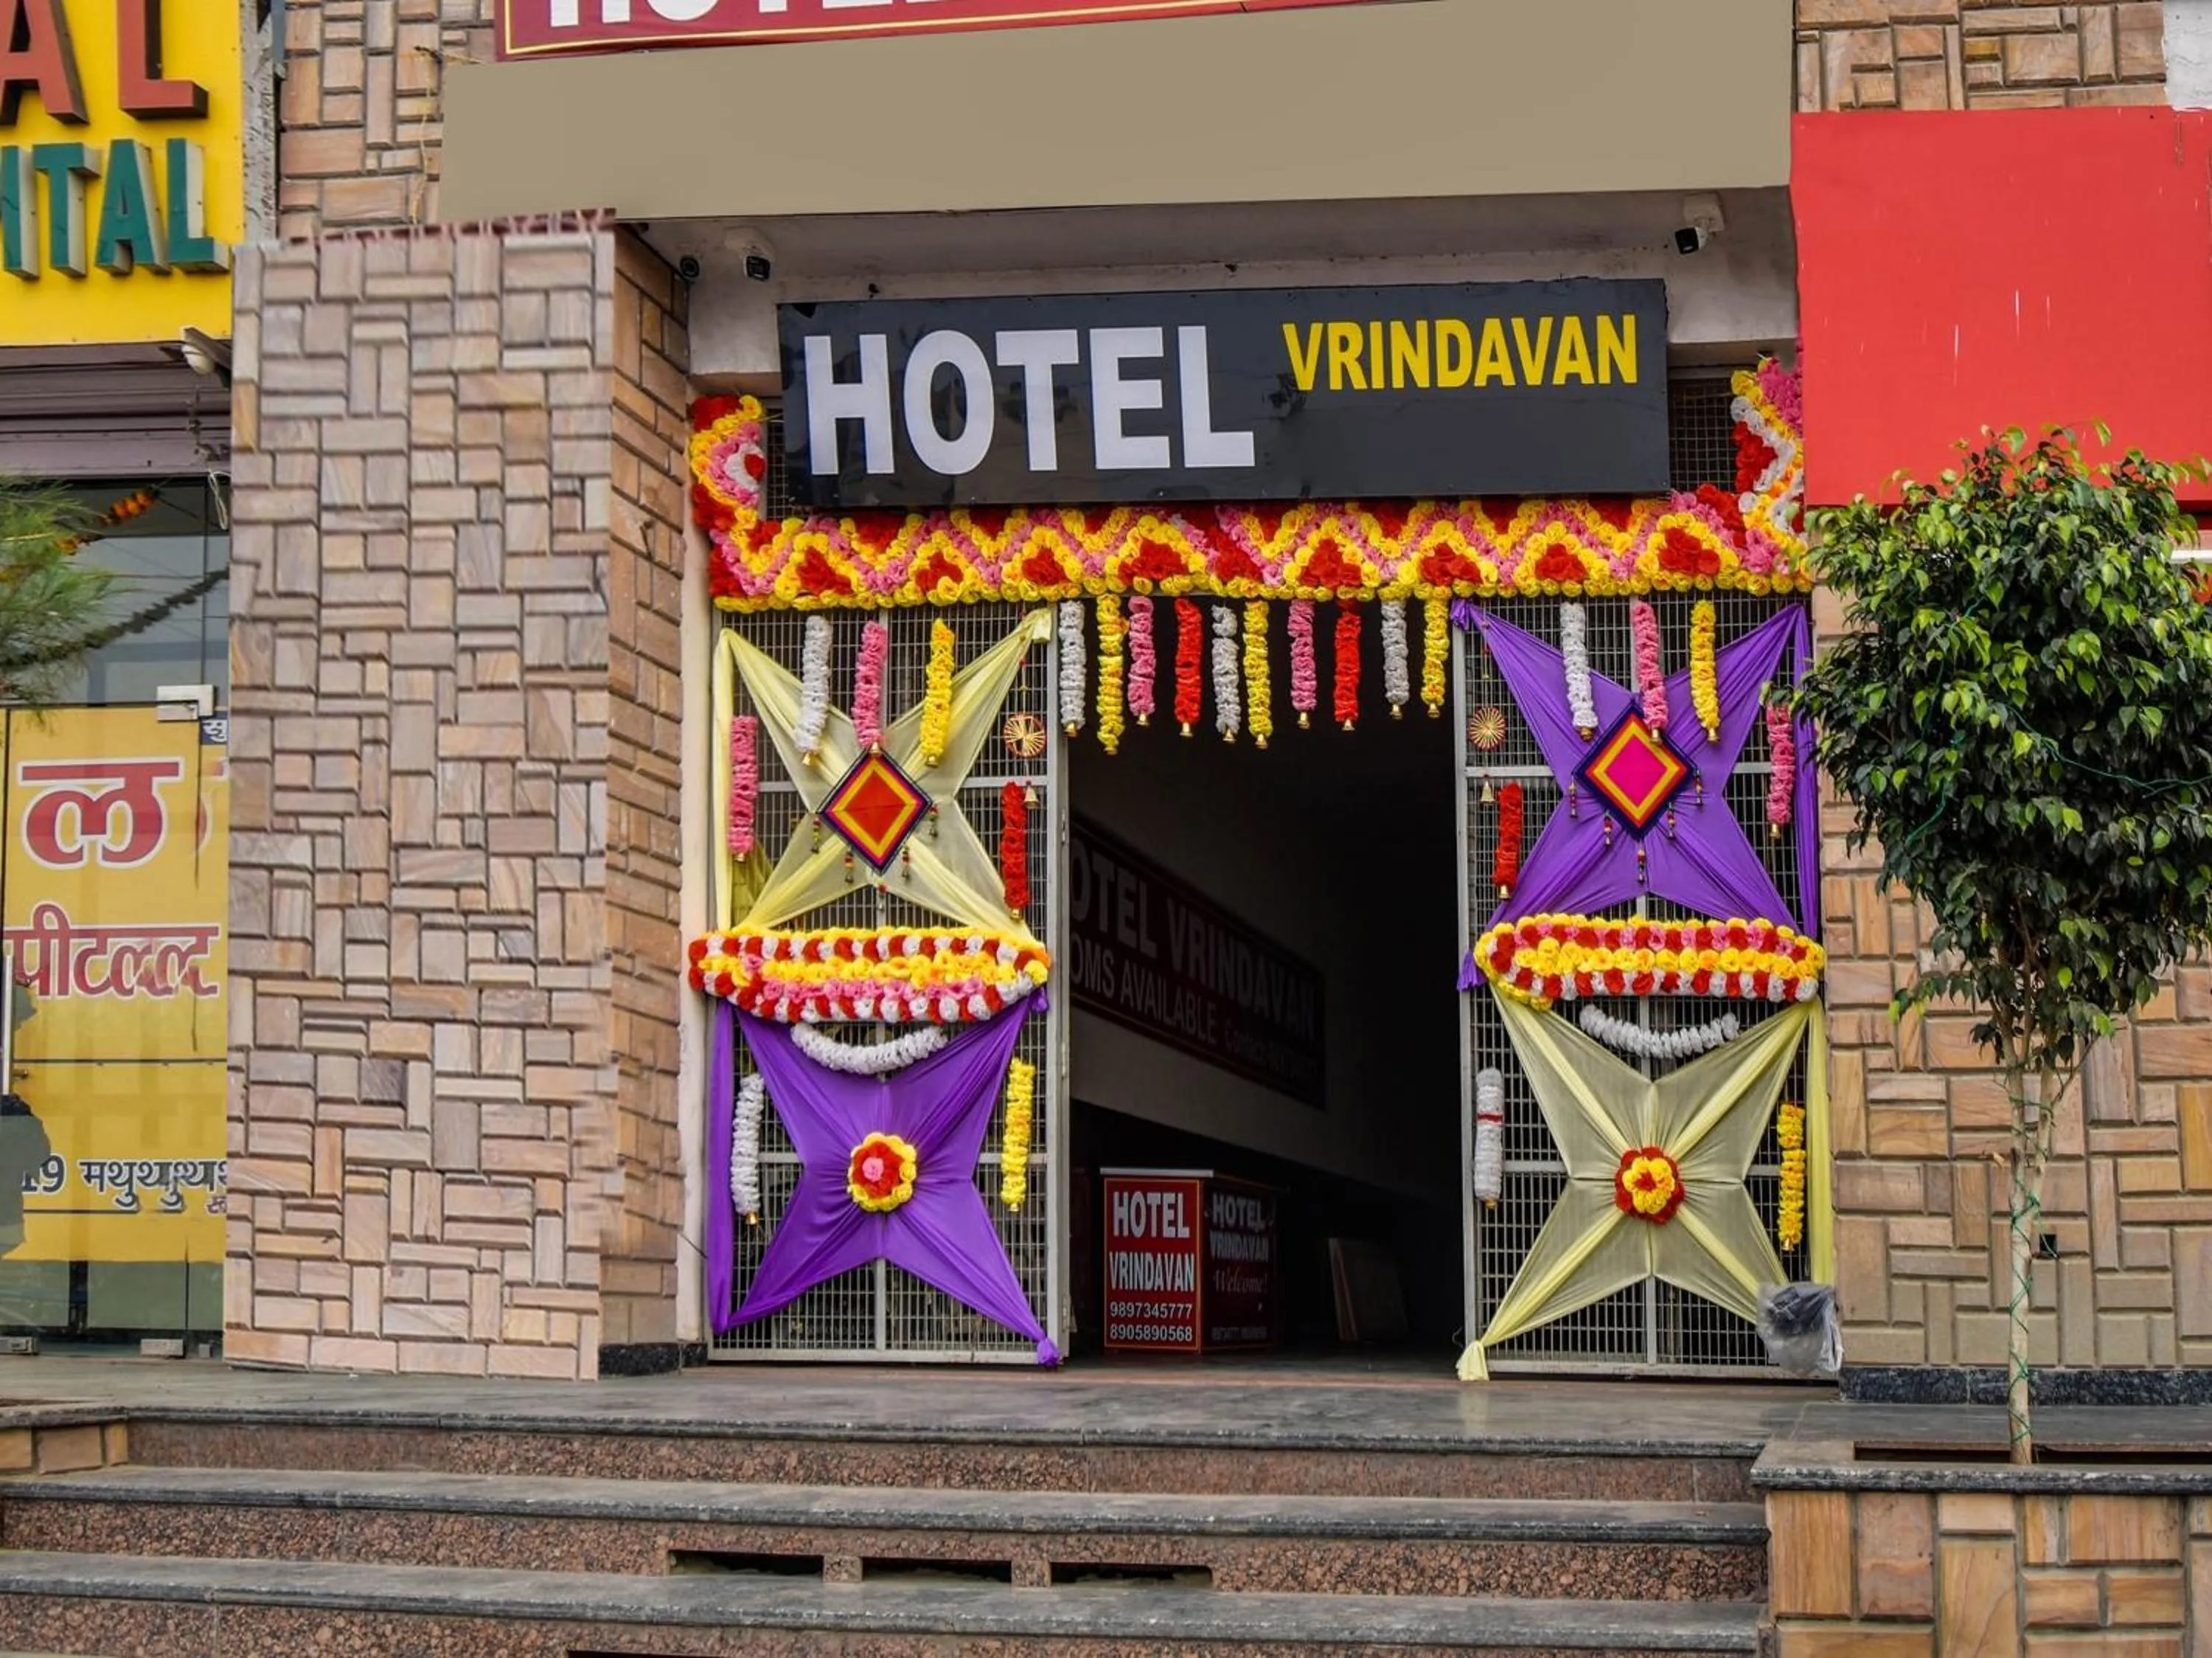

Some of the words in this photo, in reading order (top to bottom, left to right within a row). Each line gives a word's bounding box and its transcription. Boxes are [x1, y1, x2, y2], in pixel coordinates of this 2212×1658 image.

[804, 325, 1256, 476] HOTEL
[1283, 313, 1638, 392] VRINDAVAN
[1167, 895, 1316, 1041] VRINDAVAN
[1120, 959, 1218, 1045] AVAILABLE
[1113, 1191, 1190, 1238] HOTEL
[1212, 1192, 1266, 1232] HOTEL
[1109, 1251, 1194, 1291] VRINDAVAN
[1110, 1300, 1192, 1319] 9897345777
[1110, 1323, 1192, 1342] 8905890568
